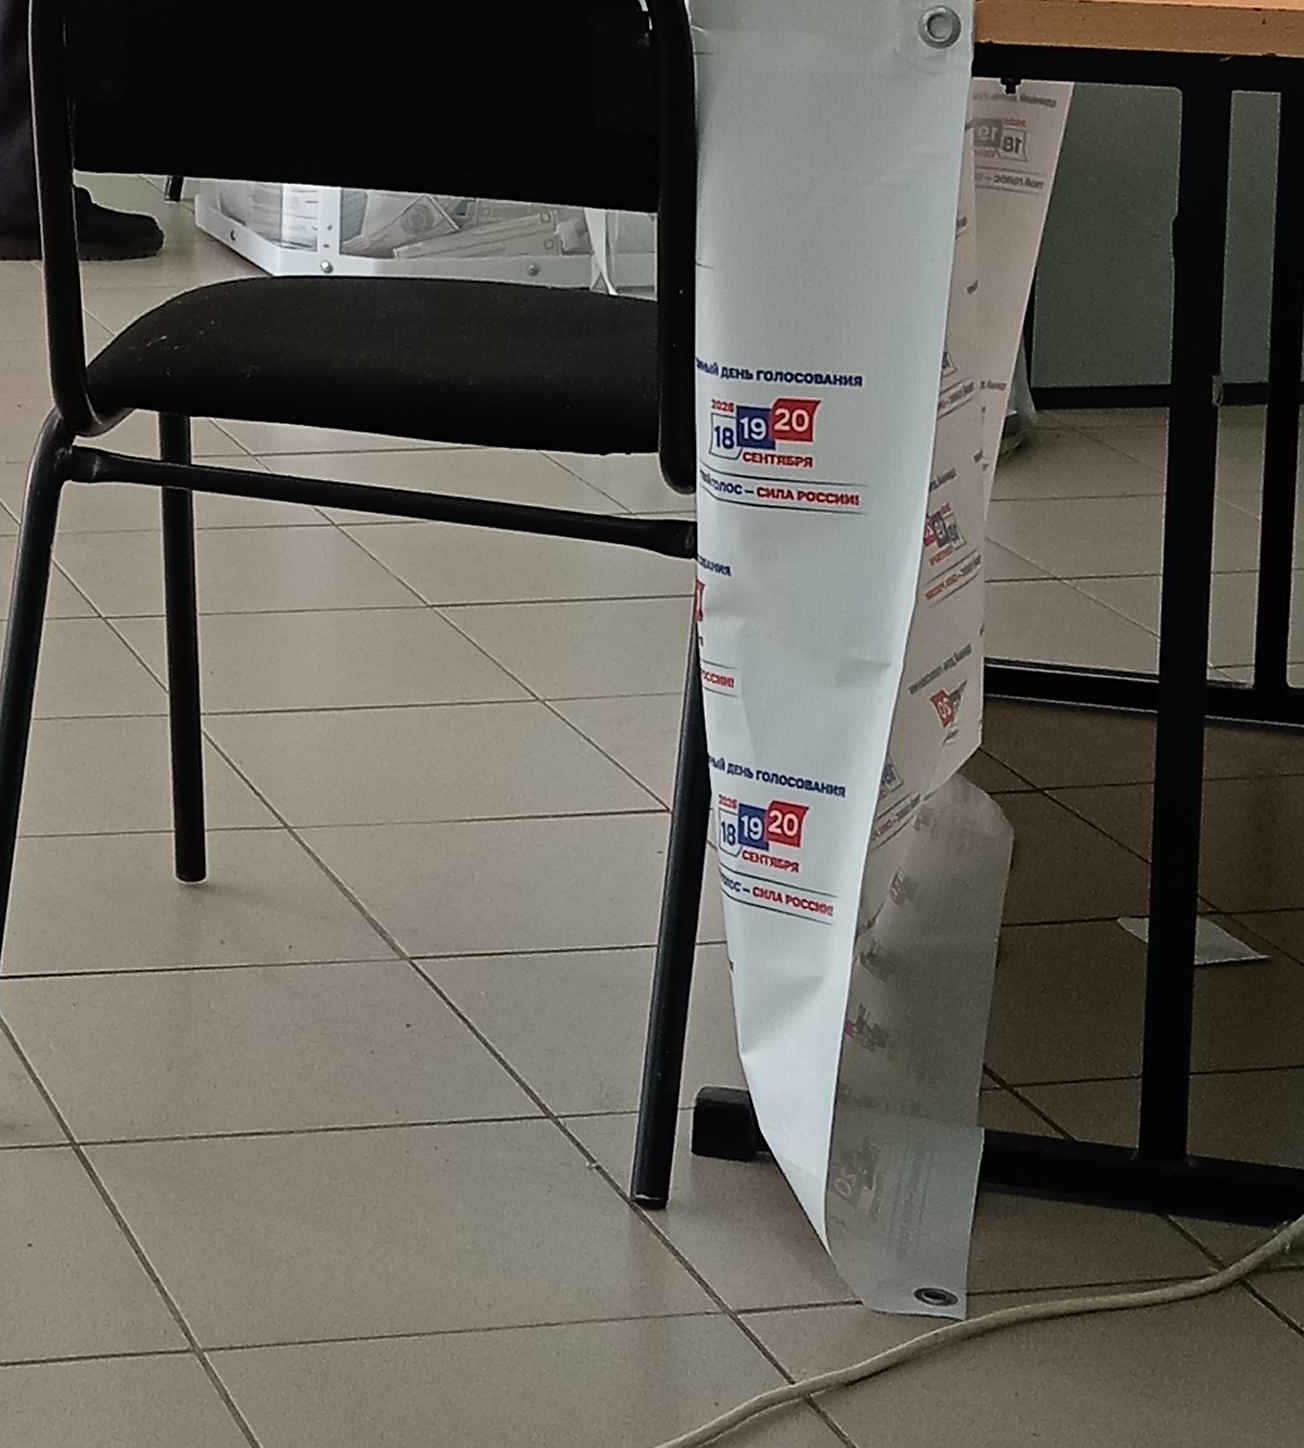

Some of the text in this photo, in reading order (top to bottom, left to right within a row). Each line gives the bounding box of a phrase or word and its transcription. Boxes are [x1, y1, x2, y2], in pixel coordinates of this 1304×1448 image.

[721, 367, 753, 380] ДЕНЬ
[757, 370, 863, 387] ГОЛОСОВАНИЯ
[714, 409, 810, 450] 18 19 20
[742, 452, 813, 468] СЕНТЯБРЯ
[756, 487, 794, 501] СИЛА
[797, 491, 860, 506] РОССИИ!
[756, 770, 846, 798] ГОЛОСОВАНИЯ
[721, 810, 799, 846] 18 19 20
[742, 850, 799, 873] СЕНТЯБРЯ
[753, 886, 783, 904] СИЛА
